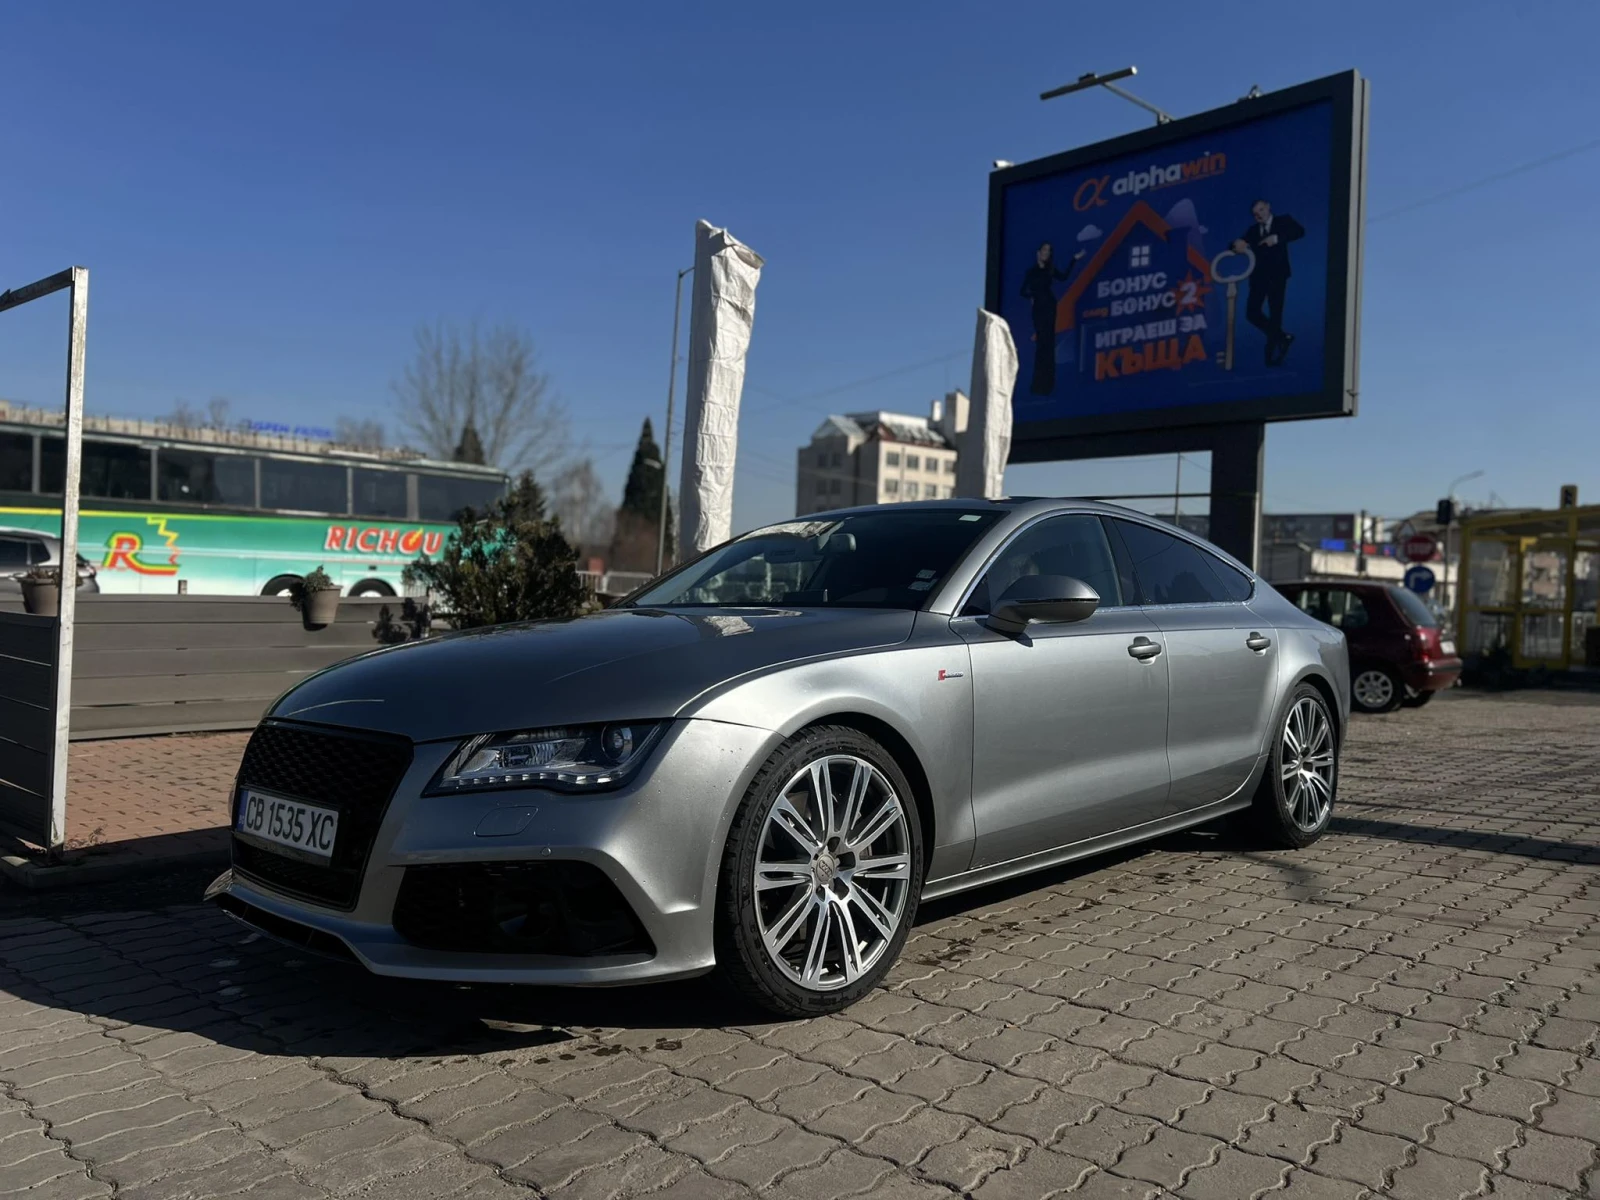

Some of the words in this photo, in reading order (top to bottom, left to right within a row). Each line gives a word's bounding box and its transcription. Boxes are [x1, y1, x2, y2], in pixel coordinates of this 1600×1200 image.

[1112, 151, 1227, 195] alphawin
[1097, 272, 1167, 298] БОНУС
[1111, 290, 1176, 316] БОНУС
[1181, 281, 1197, 305] 2
[1095, 318, 1177, 348] ИГРАЕШ
[1179, 314, 1208, 332] ЗА
[1095, 334, 1207, 381] КЪЩА
[324, 524, 444, 555] RICHOU
[246, 796, 265, 831] CB
[268, 802, 306, 843] 1535
[305, 811, 334, 850] XC
